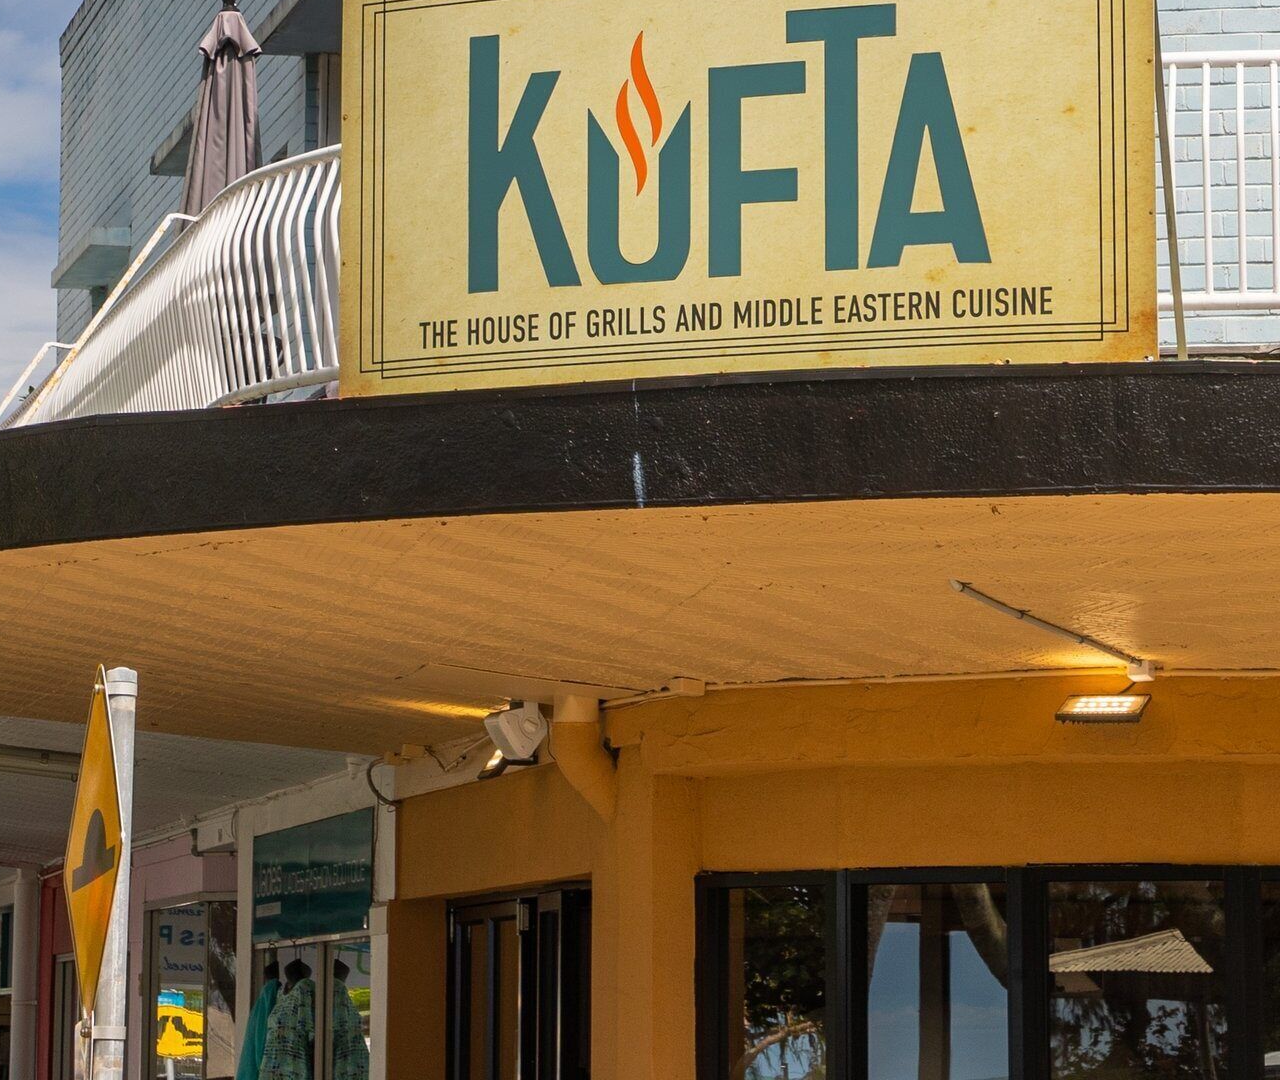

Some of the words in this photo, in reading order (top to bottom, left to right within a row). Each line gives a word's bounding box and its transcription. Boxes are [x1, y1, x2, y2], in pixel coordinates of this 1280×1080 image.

[468, 3, 992, 294] KUFTA
[419, 320, 458, 350] THE
[467, 313, 540, 346] HOUSE
[549, 311, 577, 340] OF
[586, 305, 666, 338] GRILLS
[675, 302, 722, 332] AND
[733, 296, 823, 329] MIDDLE
[833, 290, 941, 324] EASTERN
[952, 286, 1053, 319] CUISINE
